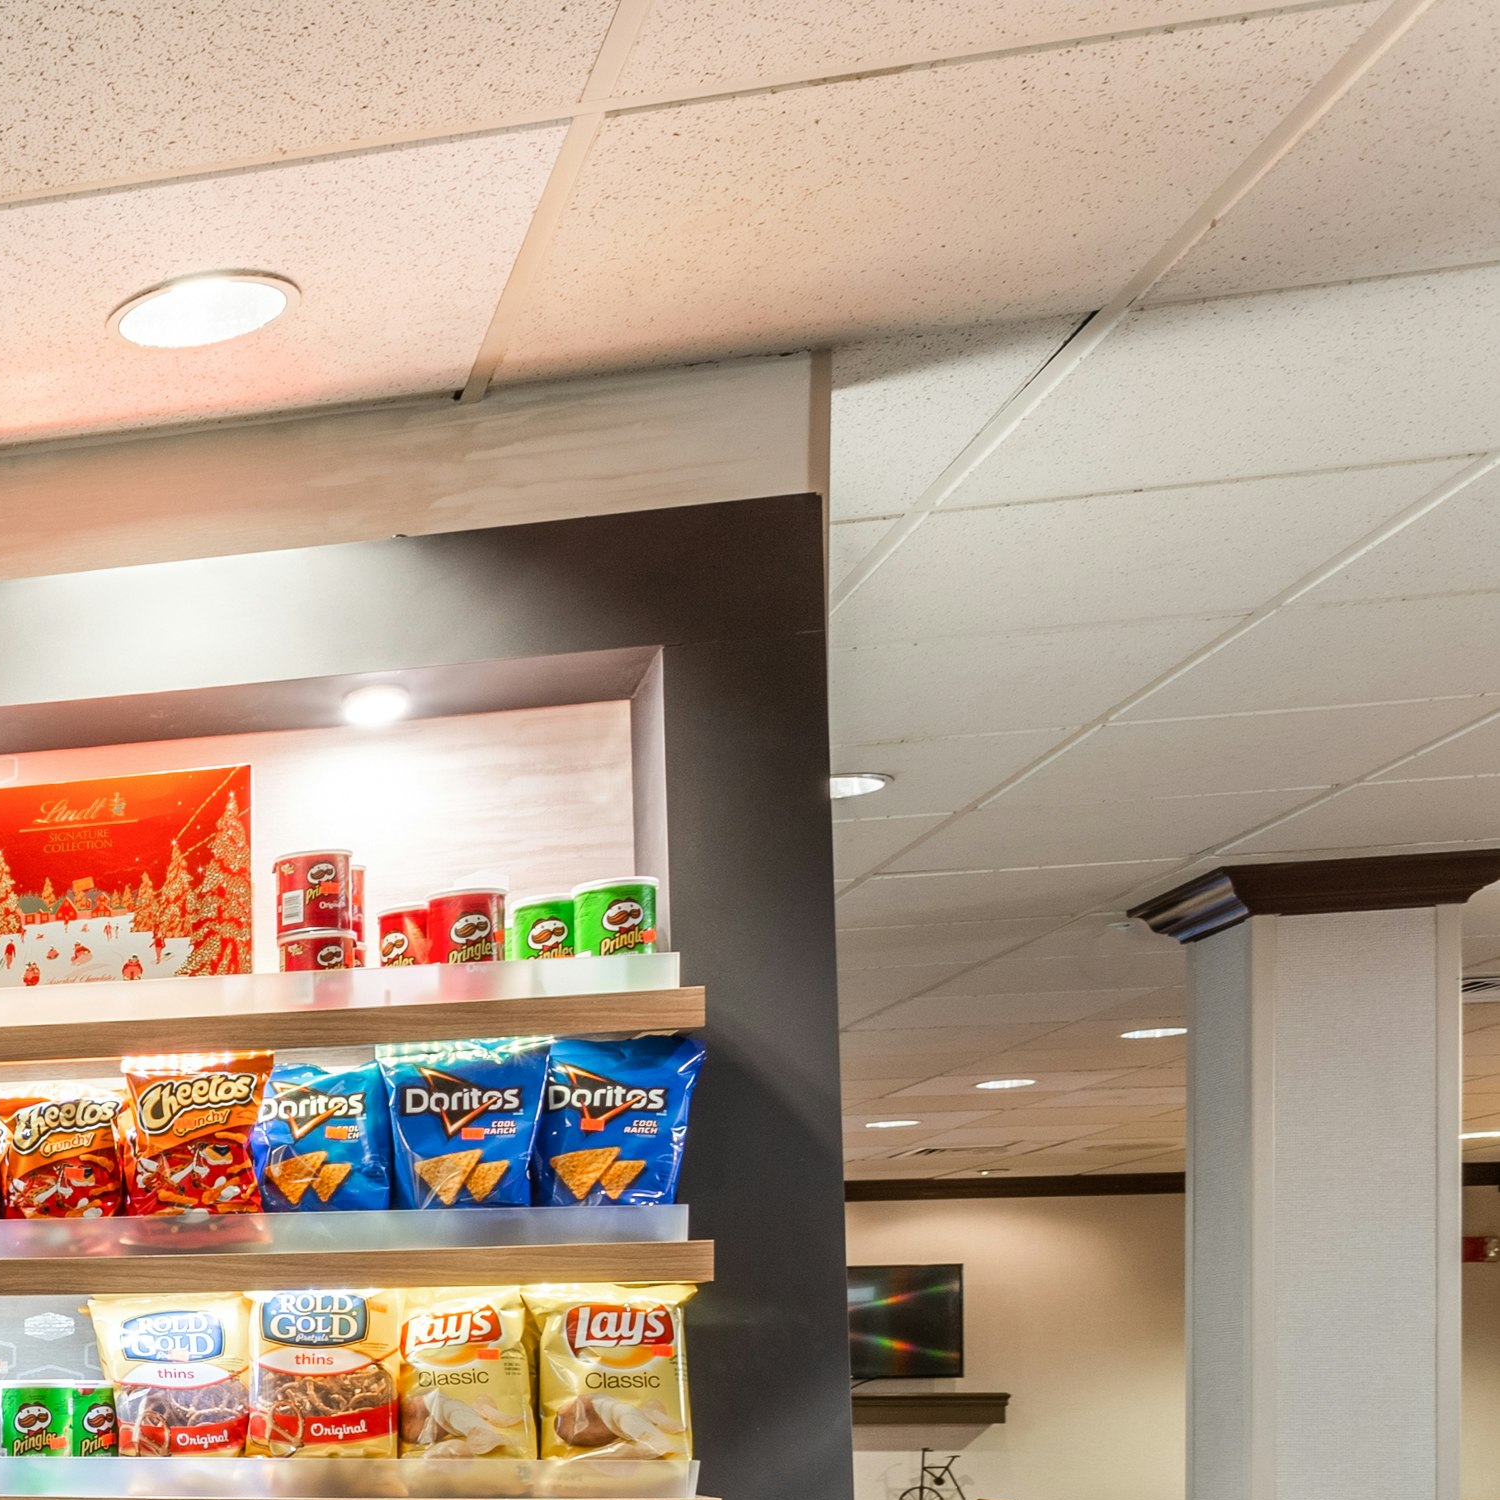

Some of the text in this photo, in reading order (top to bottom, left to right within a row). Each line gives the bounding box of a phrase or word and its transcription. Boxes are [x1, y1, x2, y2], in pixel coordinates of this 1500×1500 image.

[33, 799, 106, 824] Lindt
[43, 840, 112, 853] COLLECTION
[48, 829, 109, 842] SIGNATURE
[600, 926, 644, 955] Pringle
[139, 1074, 256, 1134] Cheetos
[257, 1093, 365, 1124] Doritos
[405, 1088, 521, 1114] Doritos
[548, 1086, 667, 1111] Doritos
[12, 1098, 120, 1154] Cheetos
[484, 1127, 517, 1135] RANCH
[491, 1120, 516, 1128] COOL
[624, 1126, 658, 1135] RANCH
[39, 1132, 95, 1157] Crunchy
[278, 1294, 353, 1316] ROLD
[137, 1312, 210, 1336] ROLD
[270, 1314, 359, 1340] GOLD
[405, 1305, 492, 1357] Lay's
[574, 1302, 667, 1350] Lay's
[131, 1333, 216, 1357] GOLD
[295, 1332, 329, 1344] Pretzels
[295, 1353, 334, 1366] thins
[157, 1368, 195, 1380] thins
[418, 1369, 489, 1388] Classic
[585, 1372, 660, 1389] Classic
[176, 1430, 230, 1449] Original
[310, 1420, 368, 1440] Original
